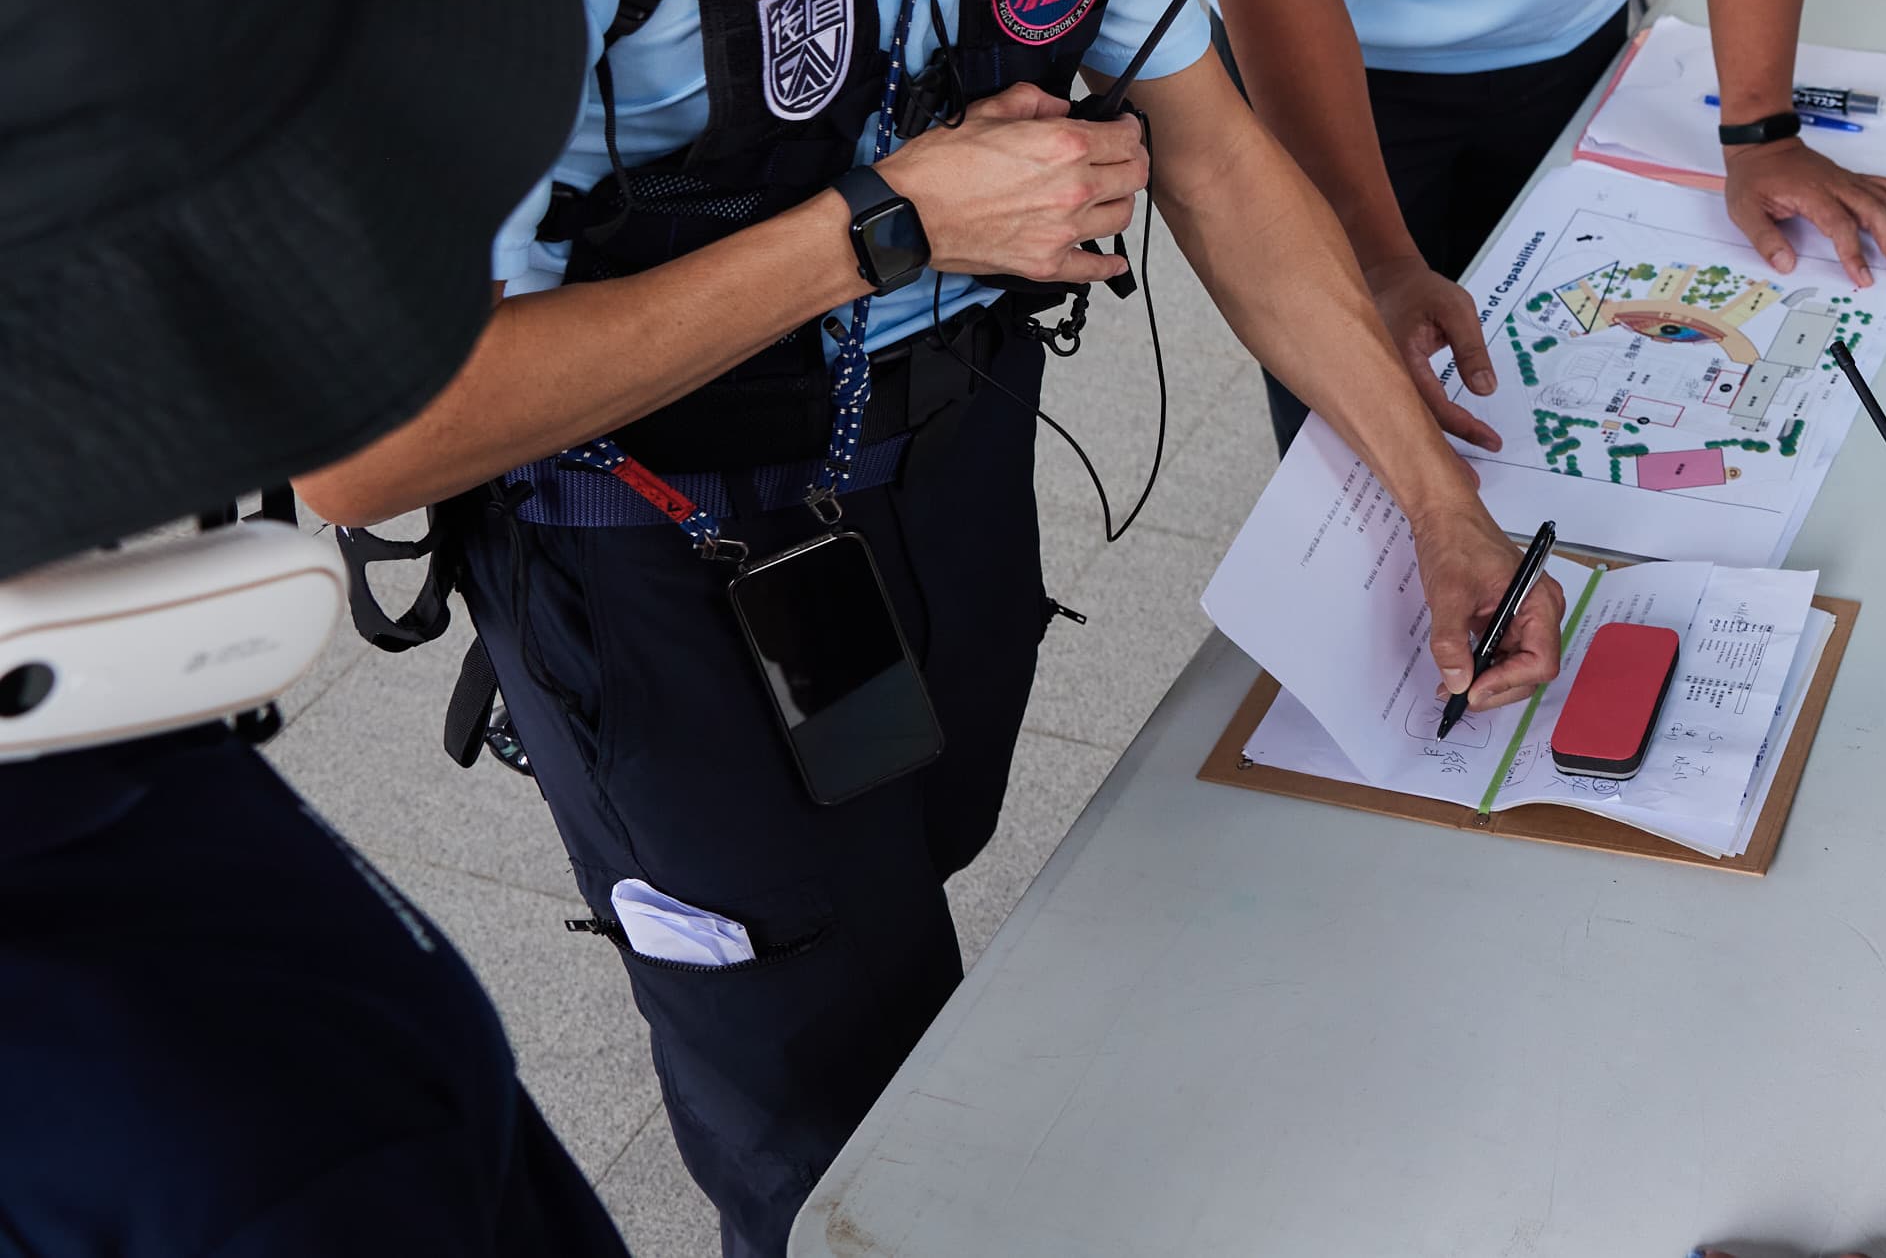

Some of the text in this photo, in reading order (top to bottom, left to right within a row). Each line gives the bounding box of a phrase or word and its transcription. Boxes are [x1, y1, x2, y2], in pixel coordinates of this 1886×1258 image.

[1050, 15, 1077, 38] DRONE
[1488, 229, 1546, 308] of Capabilities
